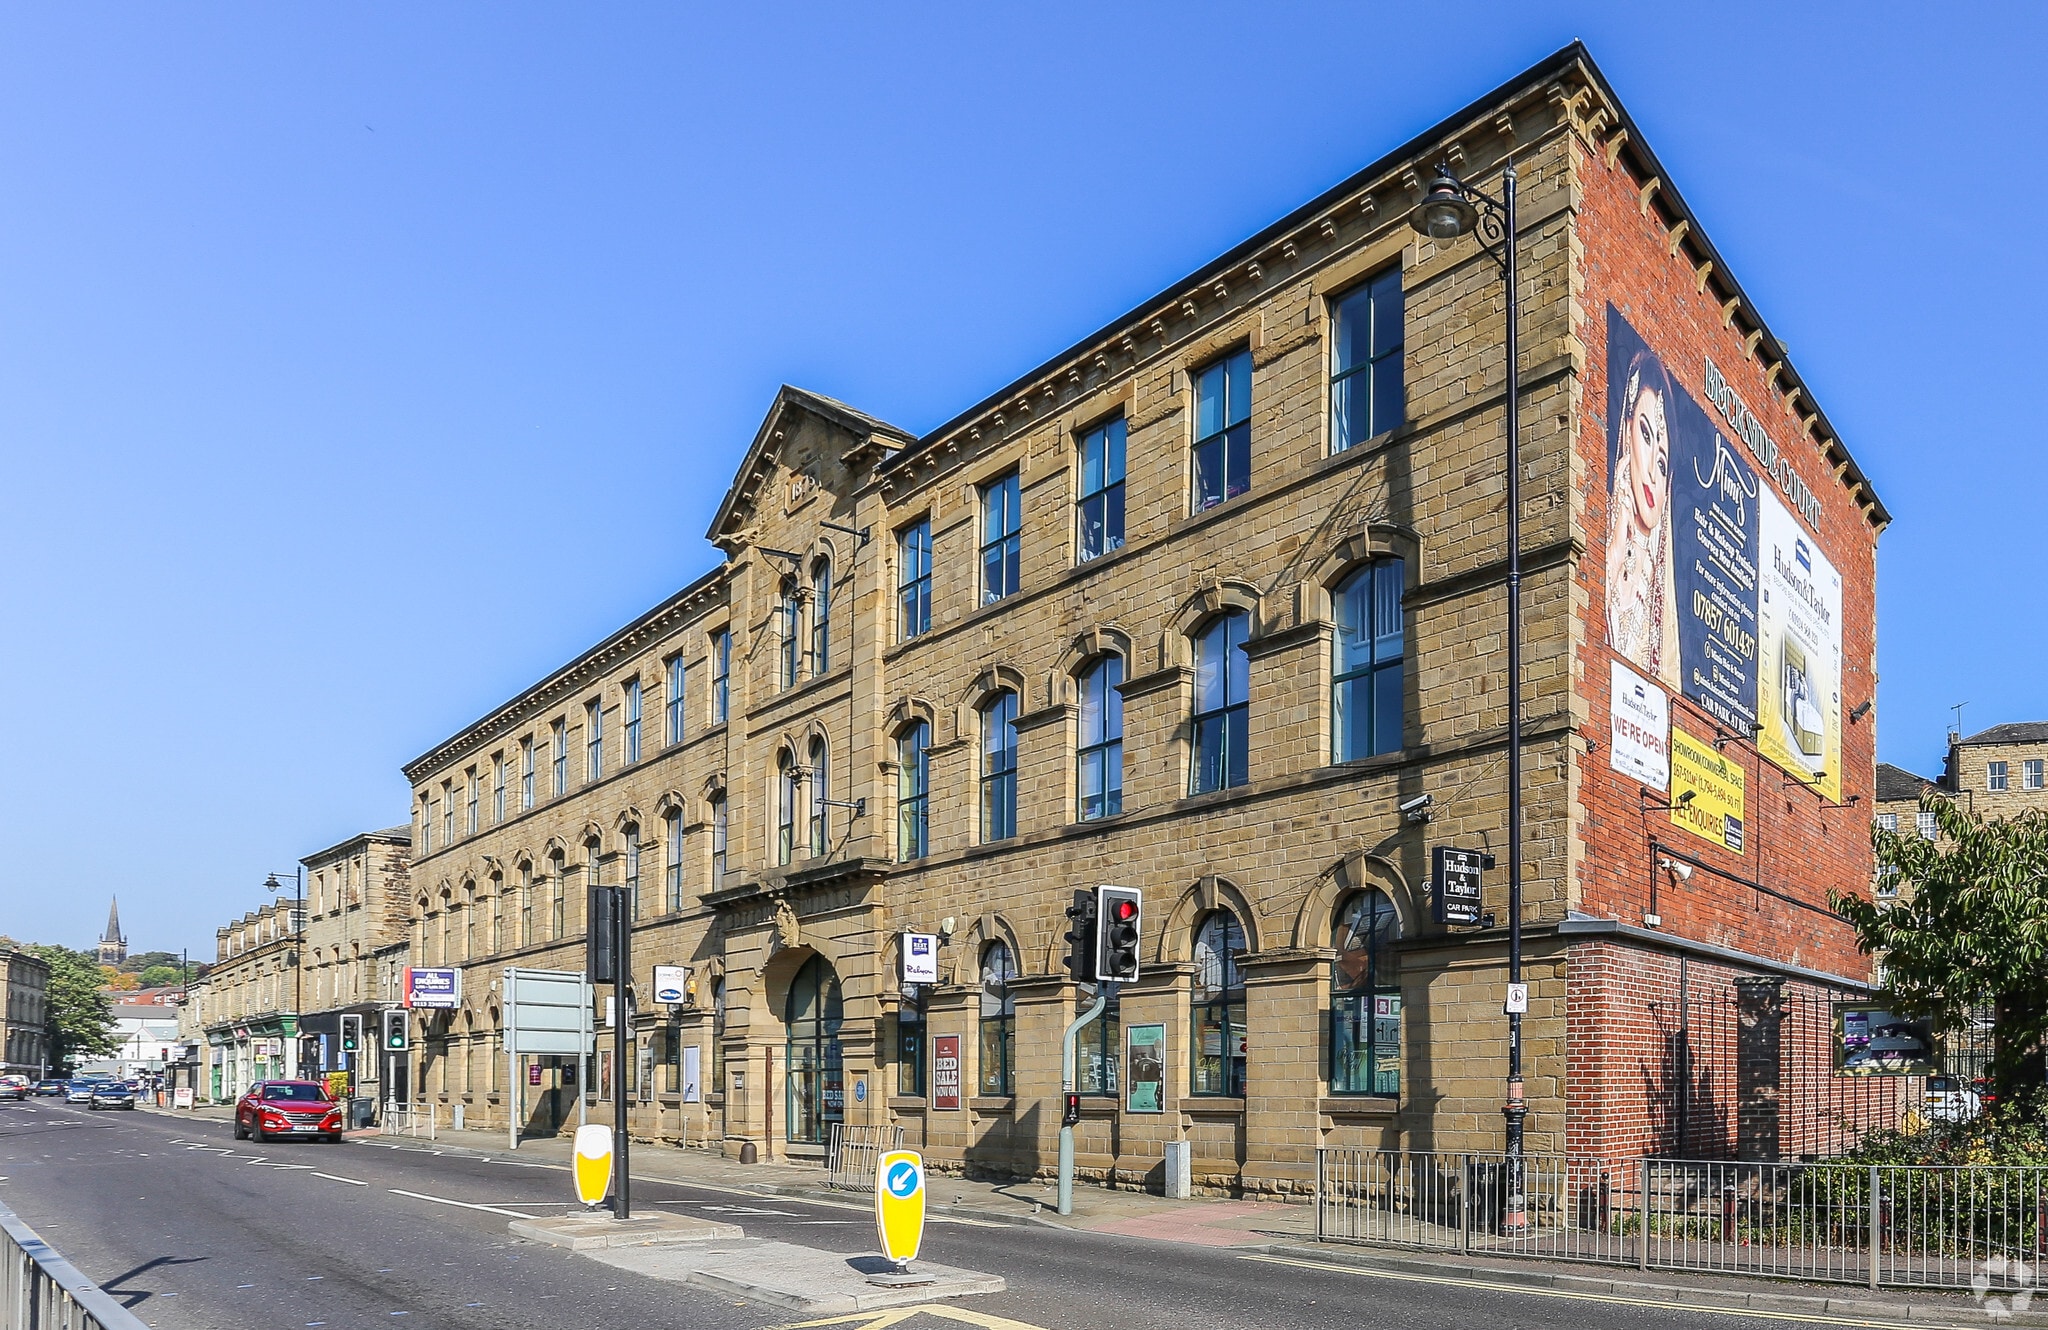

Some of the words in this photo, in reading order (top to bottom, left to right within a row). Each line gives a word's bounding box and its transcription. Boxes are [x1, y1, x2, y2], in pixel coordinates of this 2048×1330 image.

[1704, 355, 1779, 481] BECKSIDE
[1779, 458, 1822, 533] COURT
[1695, 559, 1704, 575] For
[1694, 589, 1723, 633] 07857
[1723, 617, 1756, 661] 601437
[1701, 693, 1714, 712] CAR
[1714, 702, 1730, 722] PARK
[1730, 713, 1738, 729] AT
[1739, 719, 1753, 738] REA
[1613, 713, 1641, 744] WE'RE
[1642, 731, 1665, 757] OPEN
[1730, 773, 1743, 790] SPACE
[1689, 804, 1723, 837] ENQUIRIES
[1445, 860, 1479, 875] Hudson
[1460, 874, 1466, 882] &
[1448, 880, 1476, 895] Taylor
[1447, 903, 1460, 911] CAR
[936, 1057, 957, 1070] BED
[936, 1070, 957, 1085] SALE
[823, 1090, 834, 1100] BED
[936, 1086, 949, 1097] NOW
[949, 1086, 958, 1097] ON
